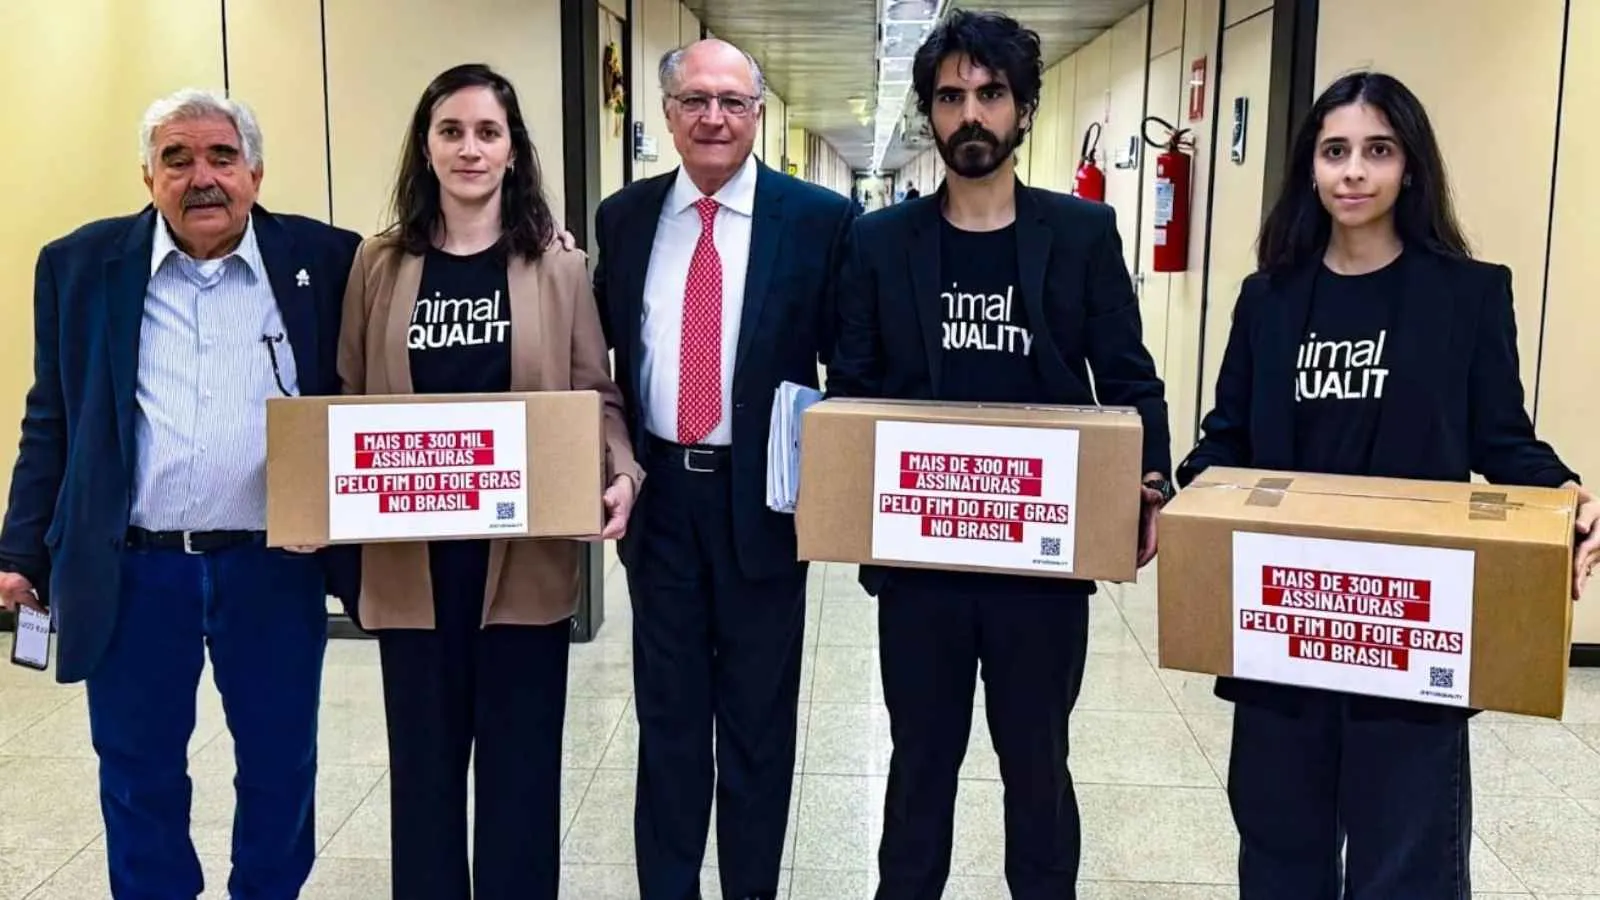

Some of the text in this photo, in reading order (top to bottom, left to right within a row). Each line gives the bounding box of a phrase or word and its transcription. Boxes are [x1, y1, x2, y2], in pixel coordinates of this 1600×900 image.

[1295, 368, 1389, 402] UALIT
[364, 432, 485, 450] MAIS DE 300 MIL
[371, 450, 475, 468] ASSINATURAS
[909, 454, 1033, 476] MAIS DE 300 MIL
[337, 471, 520, 493] PELO FIM DO FOIE GRAS
[916, 473, 1020, 494] ASSINATURAS
[389, 493, 471, 512] NO BRASIL
[881, 495, 1068, 523] PELO FIM DO FOIE GRAS
[931, 519, 1014, 541] NO BRASIL
[1272, 569, 1420, 600] MAIS DE 300 MIL
[1281, 592, 1404, 618] ASSINATURAS
[1242, 610, 1461, 652] PELO FIM DO FOIE GRAS
[1300, 640, 1399, 668] NO BRASIL
